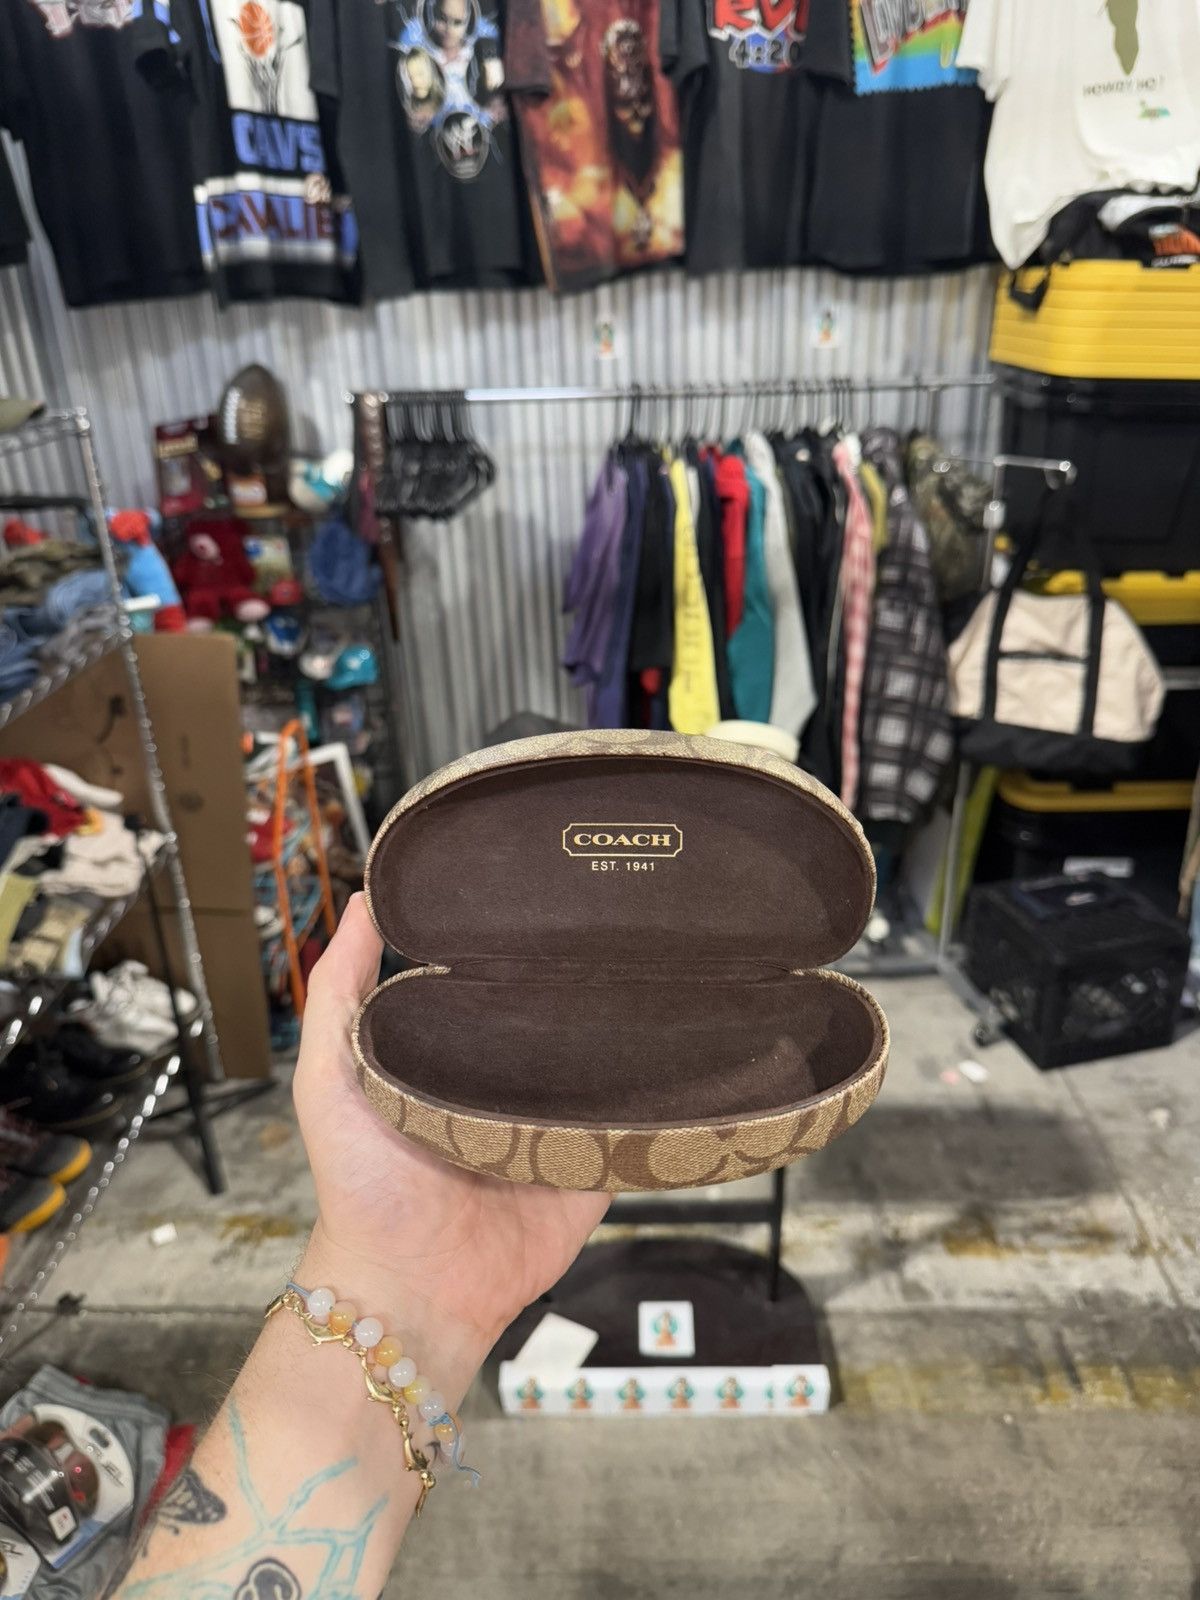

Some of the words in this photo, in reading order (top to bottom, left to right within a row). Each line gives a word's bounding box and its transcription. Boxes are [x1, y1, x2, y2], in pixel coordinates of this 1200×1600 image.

[231, 111, 326, 173] CAVS
[573, 833, 671, 846] COACH
[591, 861, 619, 872] EST.
[626, 861, 655, 872] 1941
